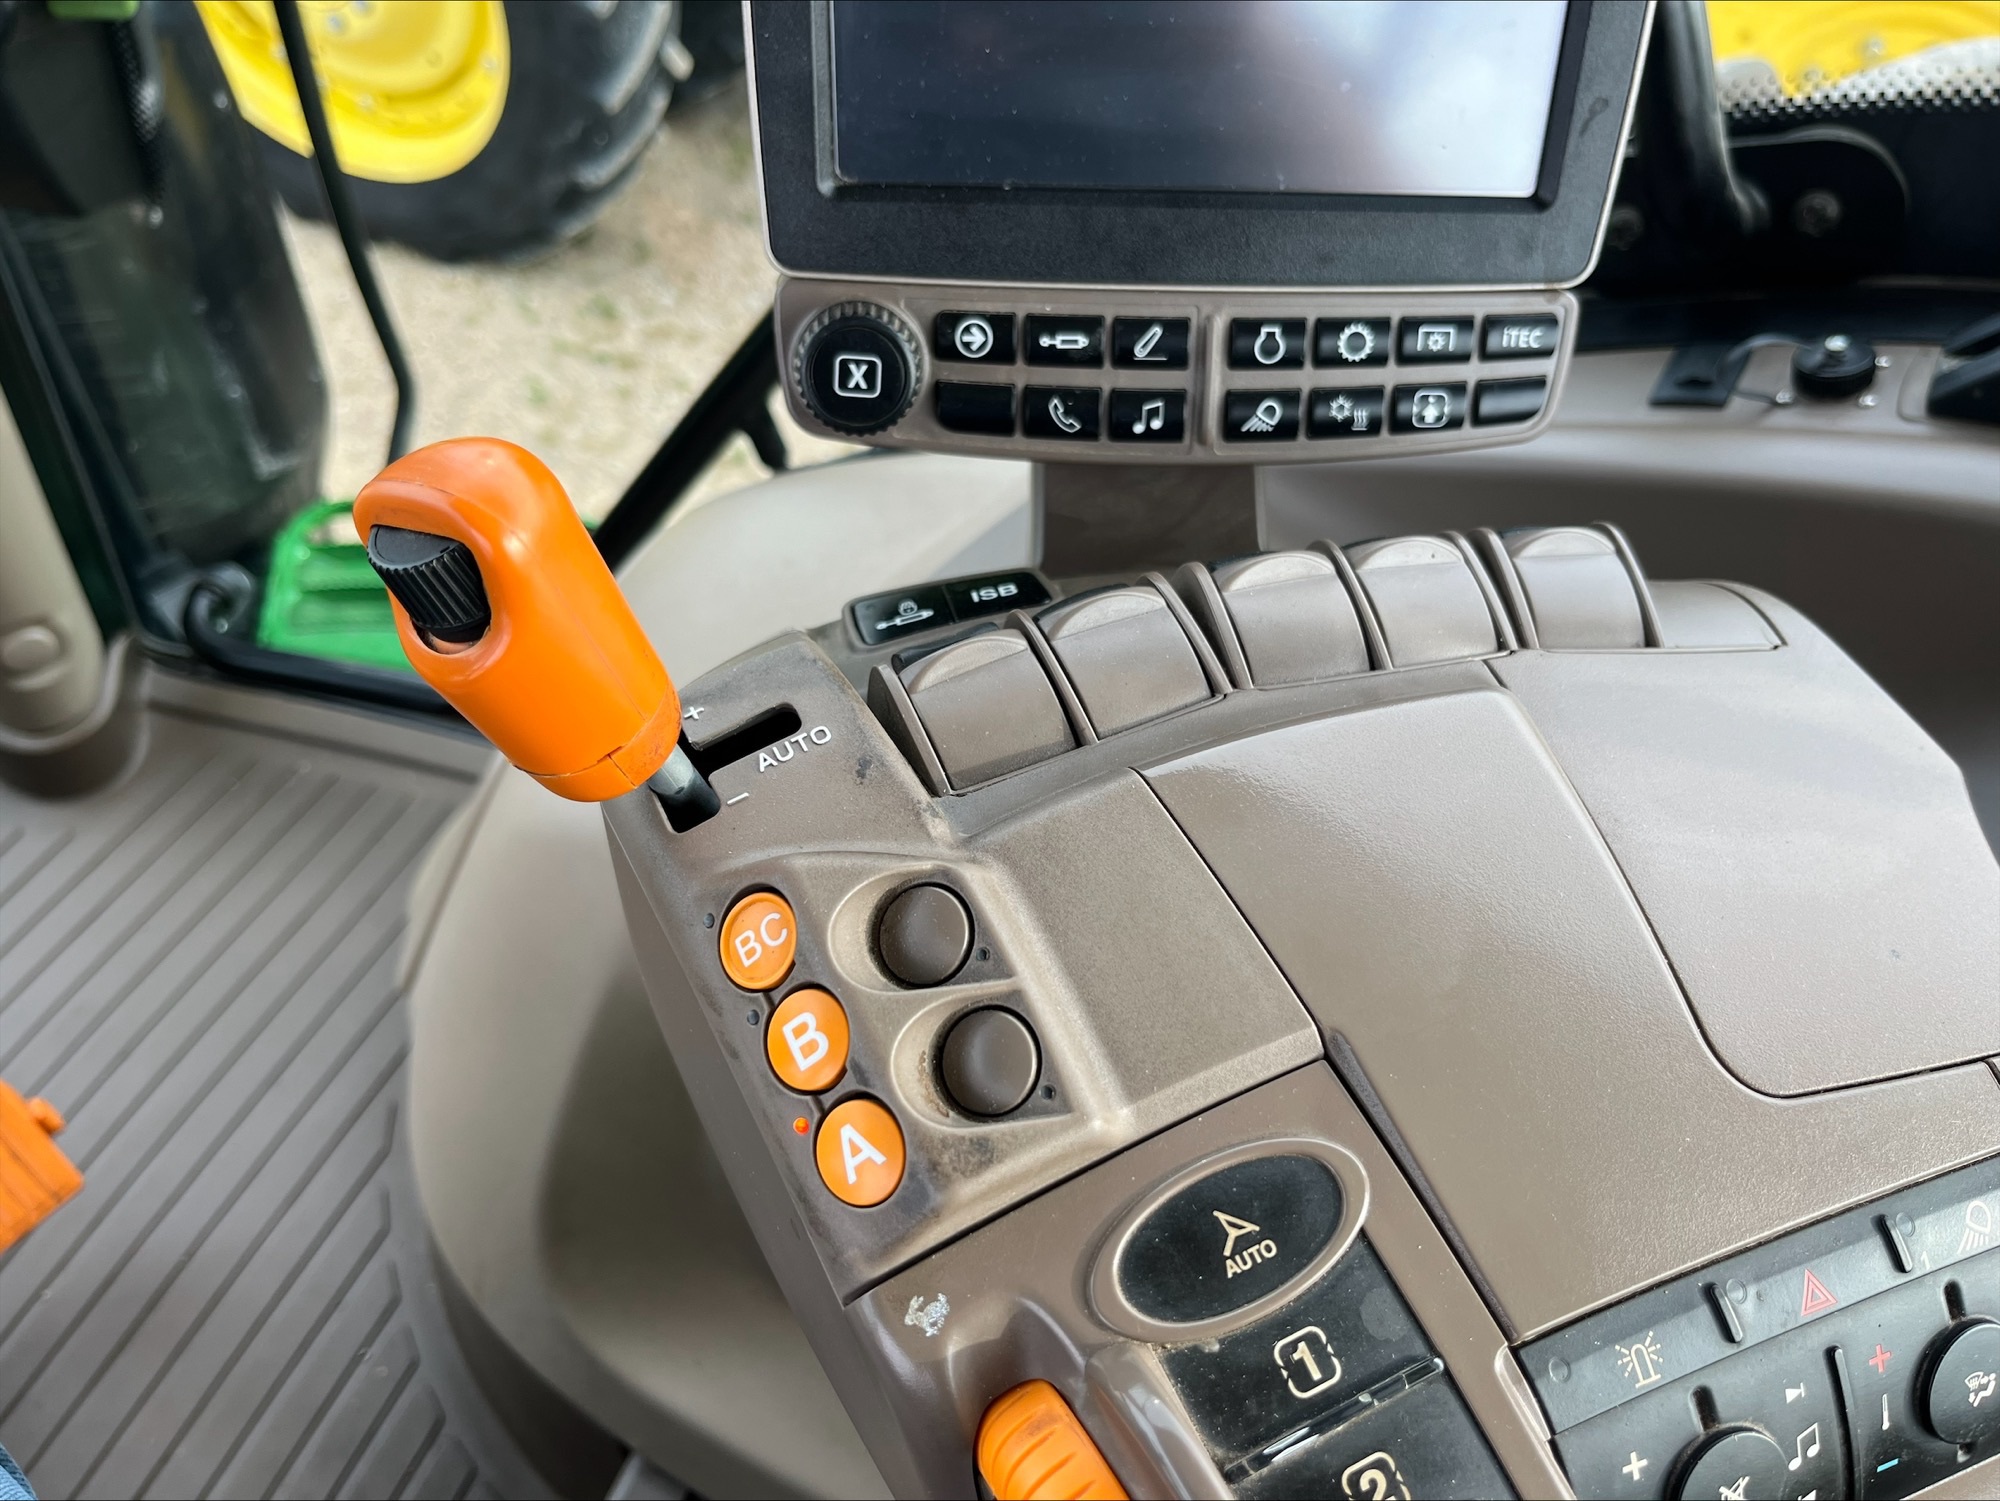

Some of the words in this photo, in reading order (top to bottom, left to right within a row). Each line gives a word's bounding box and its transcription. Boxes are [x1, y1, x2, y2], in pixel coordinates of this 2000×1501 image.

[971, 582, 1019, 603] ISB
[757, 725, 833, 773] AUTO
[734, 912, 789, 968] BC
[782, 1011, 829, 1071] B
[839, 1123, 887, 1185] A
[1224, 1239, 1278, 1279] AUTO
[1292, 1341, 1323, 1382] 1
[1359, 1468, 1390, 1501] 2
